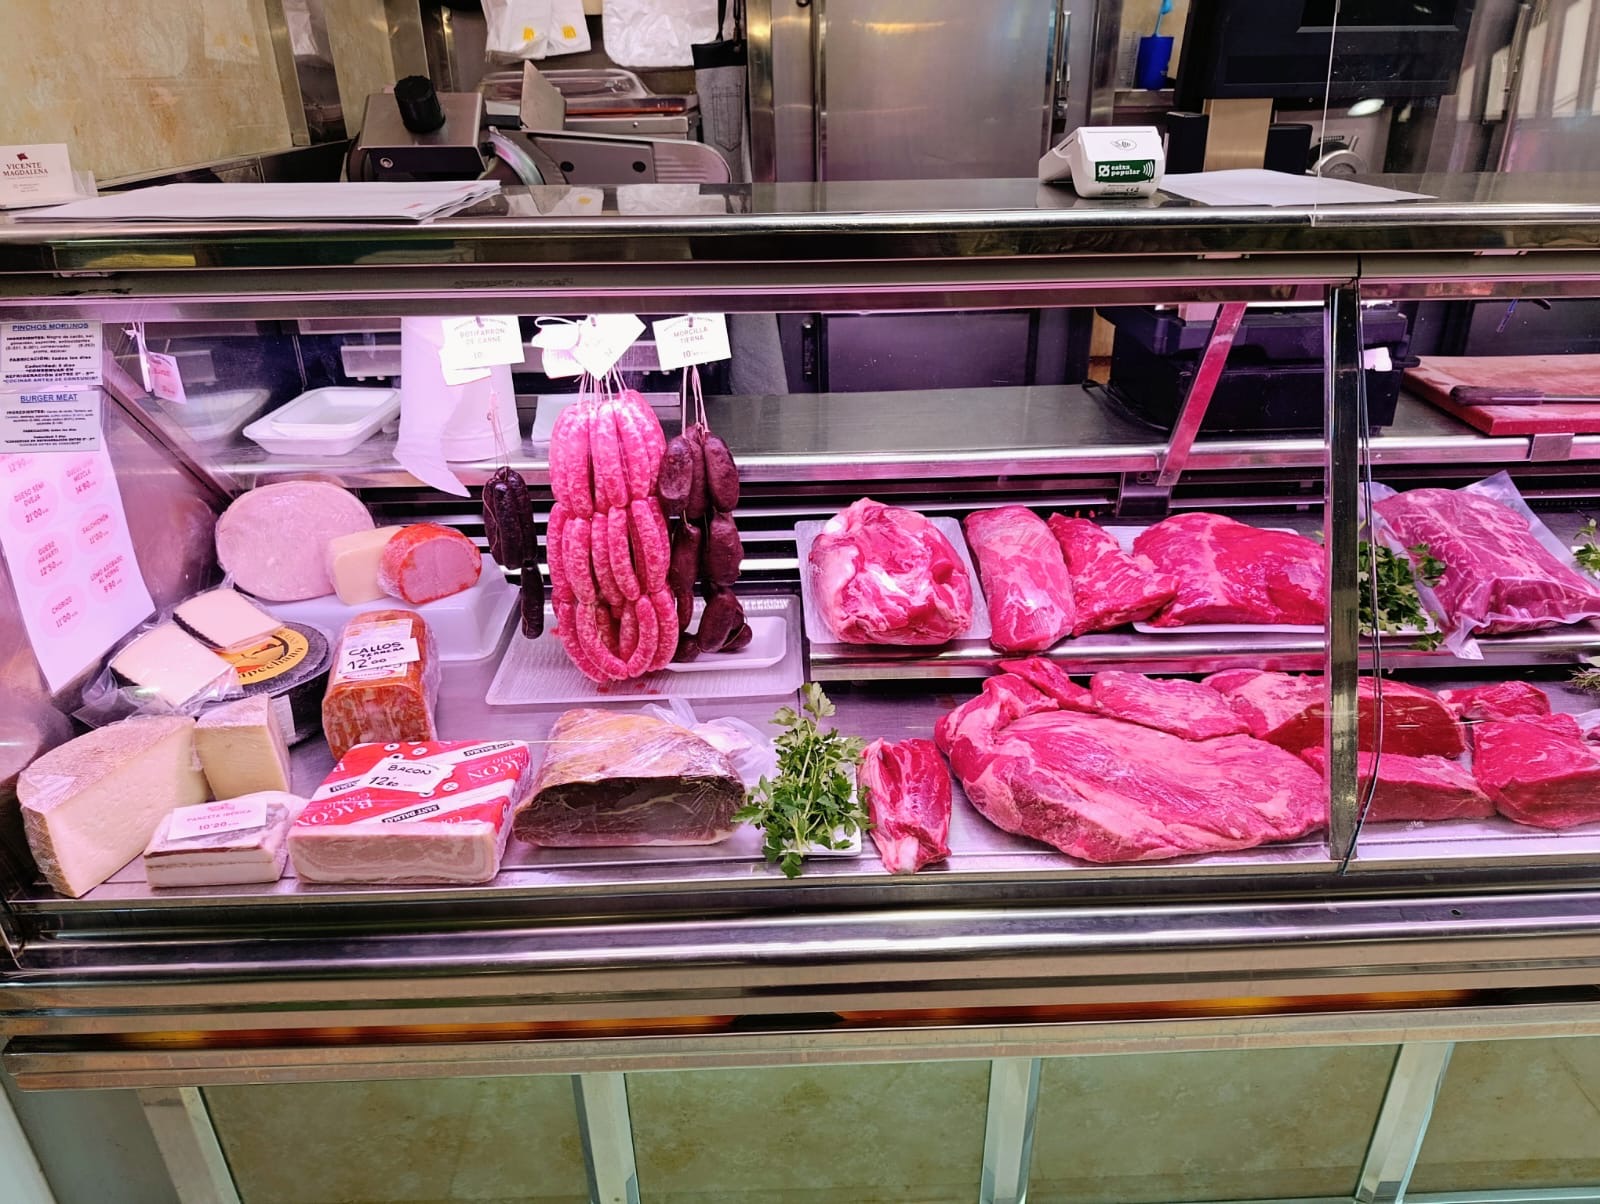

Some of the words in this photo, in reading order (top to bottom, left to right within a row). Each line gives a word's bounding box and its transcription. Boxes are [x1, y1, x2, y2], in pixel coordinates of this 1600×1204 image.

[6, 162, 41, 170] VICENTE
[1110, 169, 1140, 177] popular
[20, 394, 54, 403] BURGER
[56, 393, 78, 401] MEAT
[348, 641, 402, 656] CALLOS
[359, 646, 405, 659] TERNERA
[388, 764, 432, 776] BACON
[296, 798, 373, 828] BACON
[415, 804, 440, 817] SANT
[186, 813, 220, 822] PANCETA
